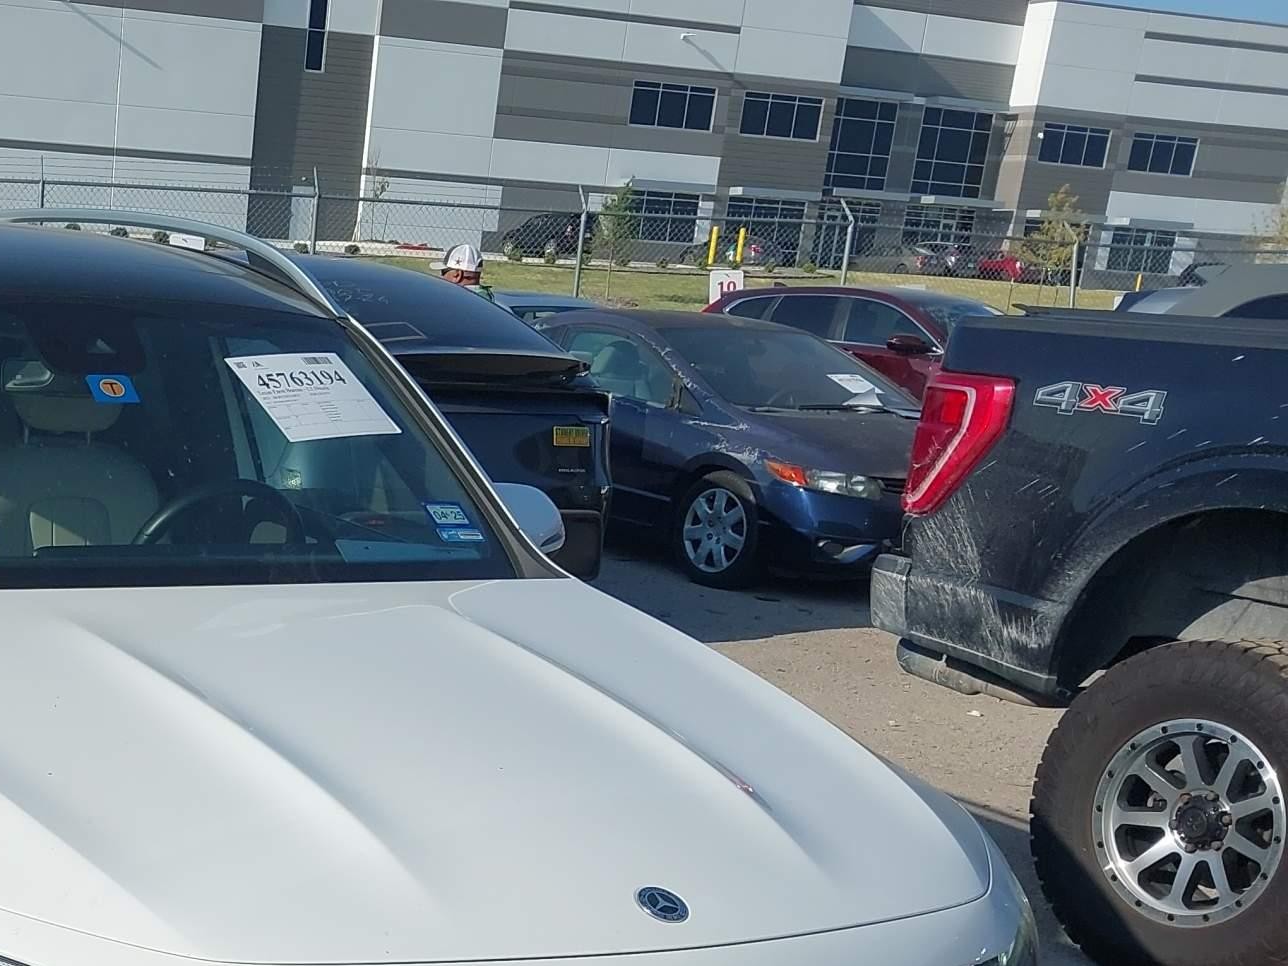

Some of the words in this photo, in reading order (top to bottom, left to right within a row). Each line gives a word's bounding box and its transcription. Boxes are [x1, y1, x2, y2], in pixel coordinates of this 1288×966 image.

[717, 281, 737, 298] 10
[257, 370, 347, 390] 45763194
[102, 382, 119, 396] T
